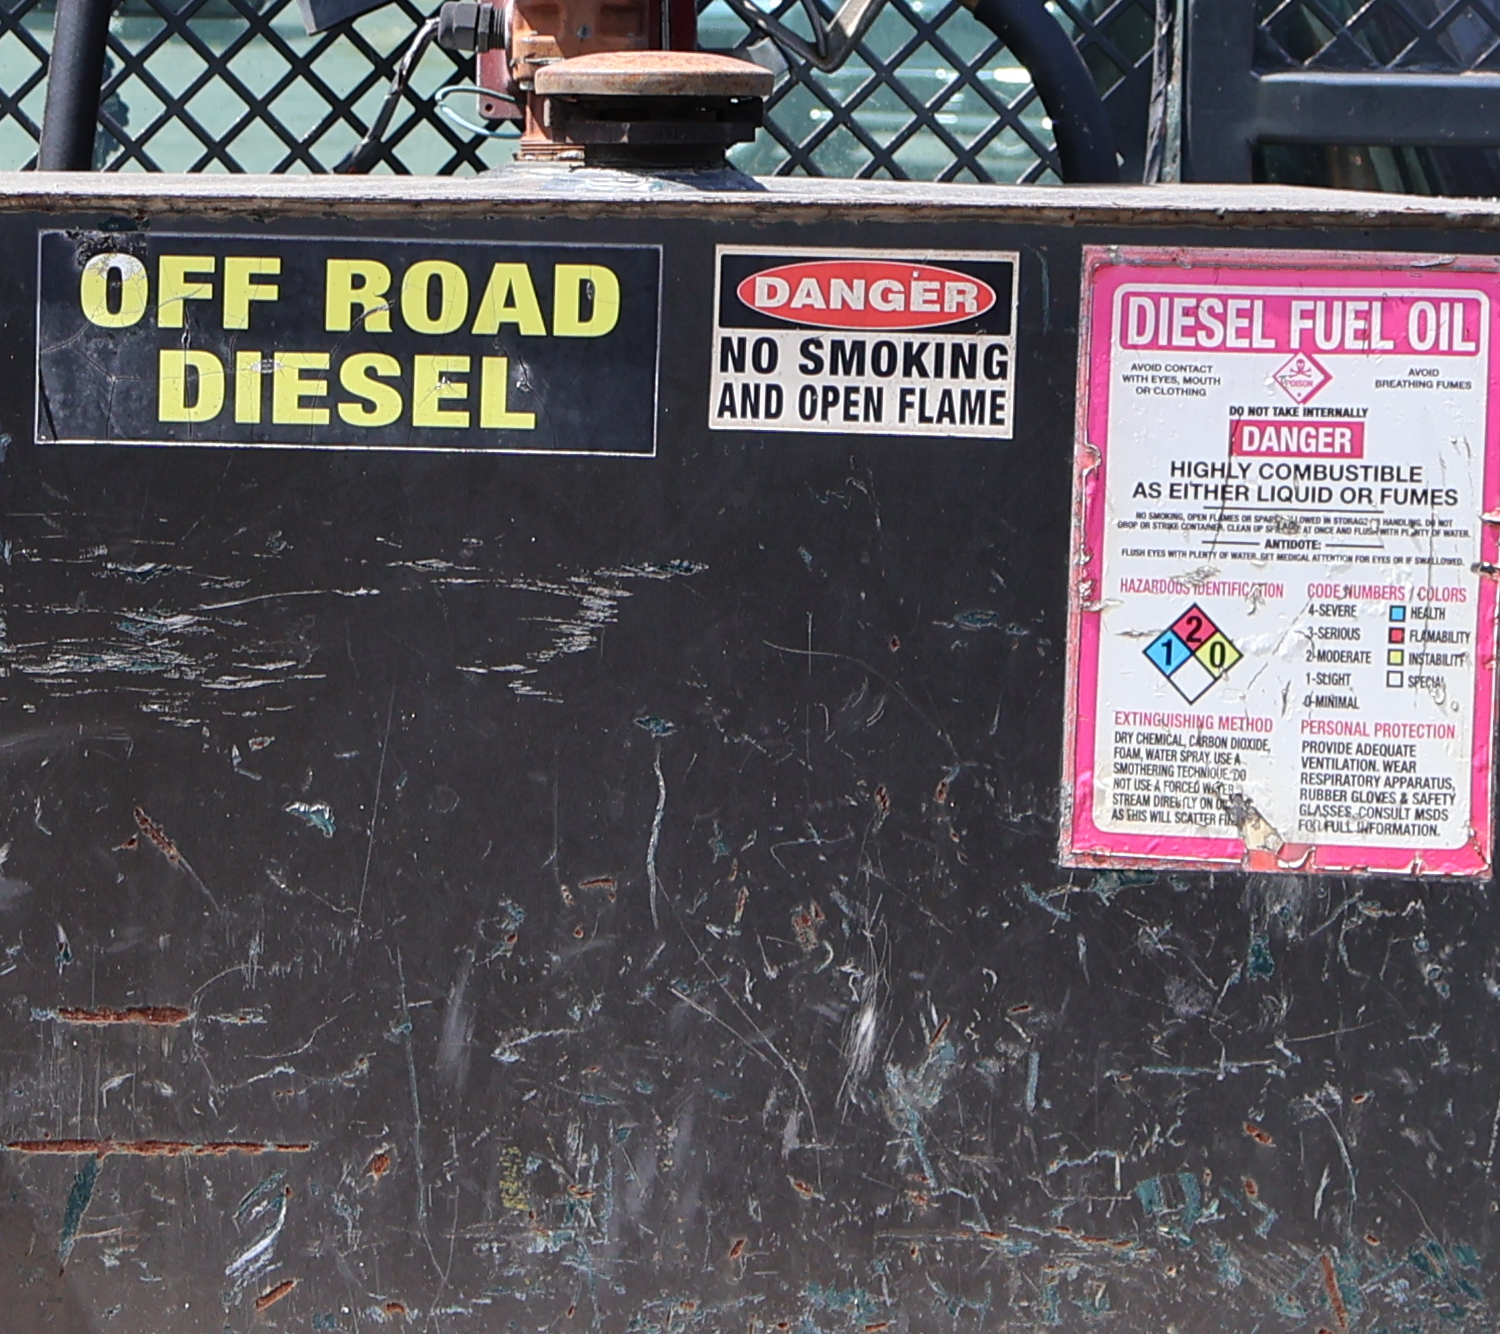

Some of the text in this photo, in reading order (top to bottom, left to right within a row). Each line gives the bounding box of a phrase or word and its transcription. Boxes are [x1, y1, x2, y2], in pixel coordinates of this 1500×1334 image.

[80, 253, 622, 337] OFF ROAD
[754, 276, 979, 313] DANGER
[1127, 296, 1476, 352] DIESEL FUEL OIL
[719, 337, 1009, 381] NO SMOKING
[1130, 363, 1214, 374] AVOID CONTACT
[1408, 368, 1440, 377] AVOID
[1122, 375, 1221, 386] WITH EYES, MOUTH
[1375, 380, 1472, 390] BREATHING FUMES
[158, 349, 536, 430] DIESEL
[1135, 386, 1207, 397] OR CLOTHING
[717, 383, 1006, 426] AND OPEN FLAME
[1229, 406, 1369, 418] DO NOT TAKE INTERNALLY
[1241, 426, 1352, 454] DANGER
[1170, 461, 1423, 483] HIGHLY COMBUSTIBLE
[1132, 482, 1458, 507] AS EITHER LIQUID OR FUMES
[1135, 511, 1147, 519] NO
[1187, 513, 1208, 521] OPEN
[1209, 513, 1240, 522] FLAMES
[1241, 514, 1252, 523] OR
[1323, 517, 1331, 525] IN
[1425, 519, 1436, 528] DO
[1438, 520, 1453, 528] NOT
[1117, 521, 1138, 530] DROP
[1140, 522, 1151, 530] OR
[1152, 523, 1179, 531] STRIKE
[1227, 524, 1251, 533] CLEAN
[1253, 524, 1263, 533] UP
[1303, 526, 1312, 534] AT
[1313, 526, 1334, 535] ONCE
[1335, 527, 1352, 535] AND
[1379, 528, 1399, 536] WITH
[1431, 529, 1442, 537] OF
[1264, 539, 1322, 549] ANTIDOTE:
[1121, 548, 1145, 557] FLUSH
[1147, 549, 1166, 558] EYES
[1168, 550, 1187, 558] WITH
[1189, 550, 1217, 559] PLENTY
[1219, 551, 1229, 560] OF
[1260, 552, 1274, 560] GET
[1276, 553, 1310, 562] MEDICAL
[1312, 554, 1353, 563] ATTENTION
[1354, 555, 1370, 563] FOR
[1372, 556, 1391, 564] EYES
[1393, 556, 1403, 564] OR
[1405, 556, 1413, 565] IF
[1120, 578, 1284, 598] HAZARDOUS IDENTIFICATION
[1307, 583, 1341, 599] CODE
[1344, 584, 1406, 601] NUMBERS
[1418, 586, 1467, 603] COLORS
[1308, 603, 1357, 618] 4-SEVERE
[1410, 607, 1446, 620] HEALTH
[1185, 615, 1203, 643] 2
[1307, 626, 1361, 641] 3-SERIOUS
[1409, 630, 1471, 644] FLAMABILITY
[1161, 638, 1173, 666] 1
[1209, 641, 1226, 668] 0
[1306, 650, 1372, 664] 2-MODERATE
[1408, 653, 1466, 667] INSTABILITY
[1305, 672, 1352, 686] 1-SLIGHT
[1304, 695, 1360, 709] 0-MINIMAL
[1114, 711, 1273, 733] EXTINGUISHING METHOD
[1300, 719, 1456, 739] PERSONAL PROTECTION
[1114, 731, 1271, 753] DRY CHEMICAL, CARBON DIOXIDE,
[1301, 740, 1416, 758] PROVIDE ADEQUATE
[1114, 747, 1143, 762] FOAM,
[1145, 748, 1178, 762] WATER
[1214, 752, 1232, 765] USE
[1234, 753, 1241, 766] A
[1301, 756, 1416, 773] VENTILATION. WEAR
[1113, 762, 1174, 778] SMOTHERING
[1233, 768, 1247, 782] DO
[1113, 778, 1132, 791] NOT
[1134, 779, 1152, 792] USE
[1154, 779, 1160, 792] A
[1163, 780, 1200, 794] FORCED
[1300, 772, 1456, 792] RESPIRATORY APPARATUS,
[1112, 793, 1150, 807] STREAM
[1200, 797, 1213, 810] ON
[1300, 788, 1456, 807] RUBBER GLOVES & SAFETY
[1111, 808, 1124, 821] AS
[1126, 808, 1147, 822] THIS
[1150, 810, 1172, 823] WILL
[1174, 811, 1216, 826] SCATTER
[1358, 806, 1411, 821] CONSULT
[1414, 808, 1449, 822] MSDS
[1324, 820, 1352, 834] FULL
